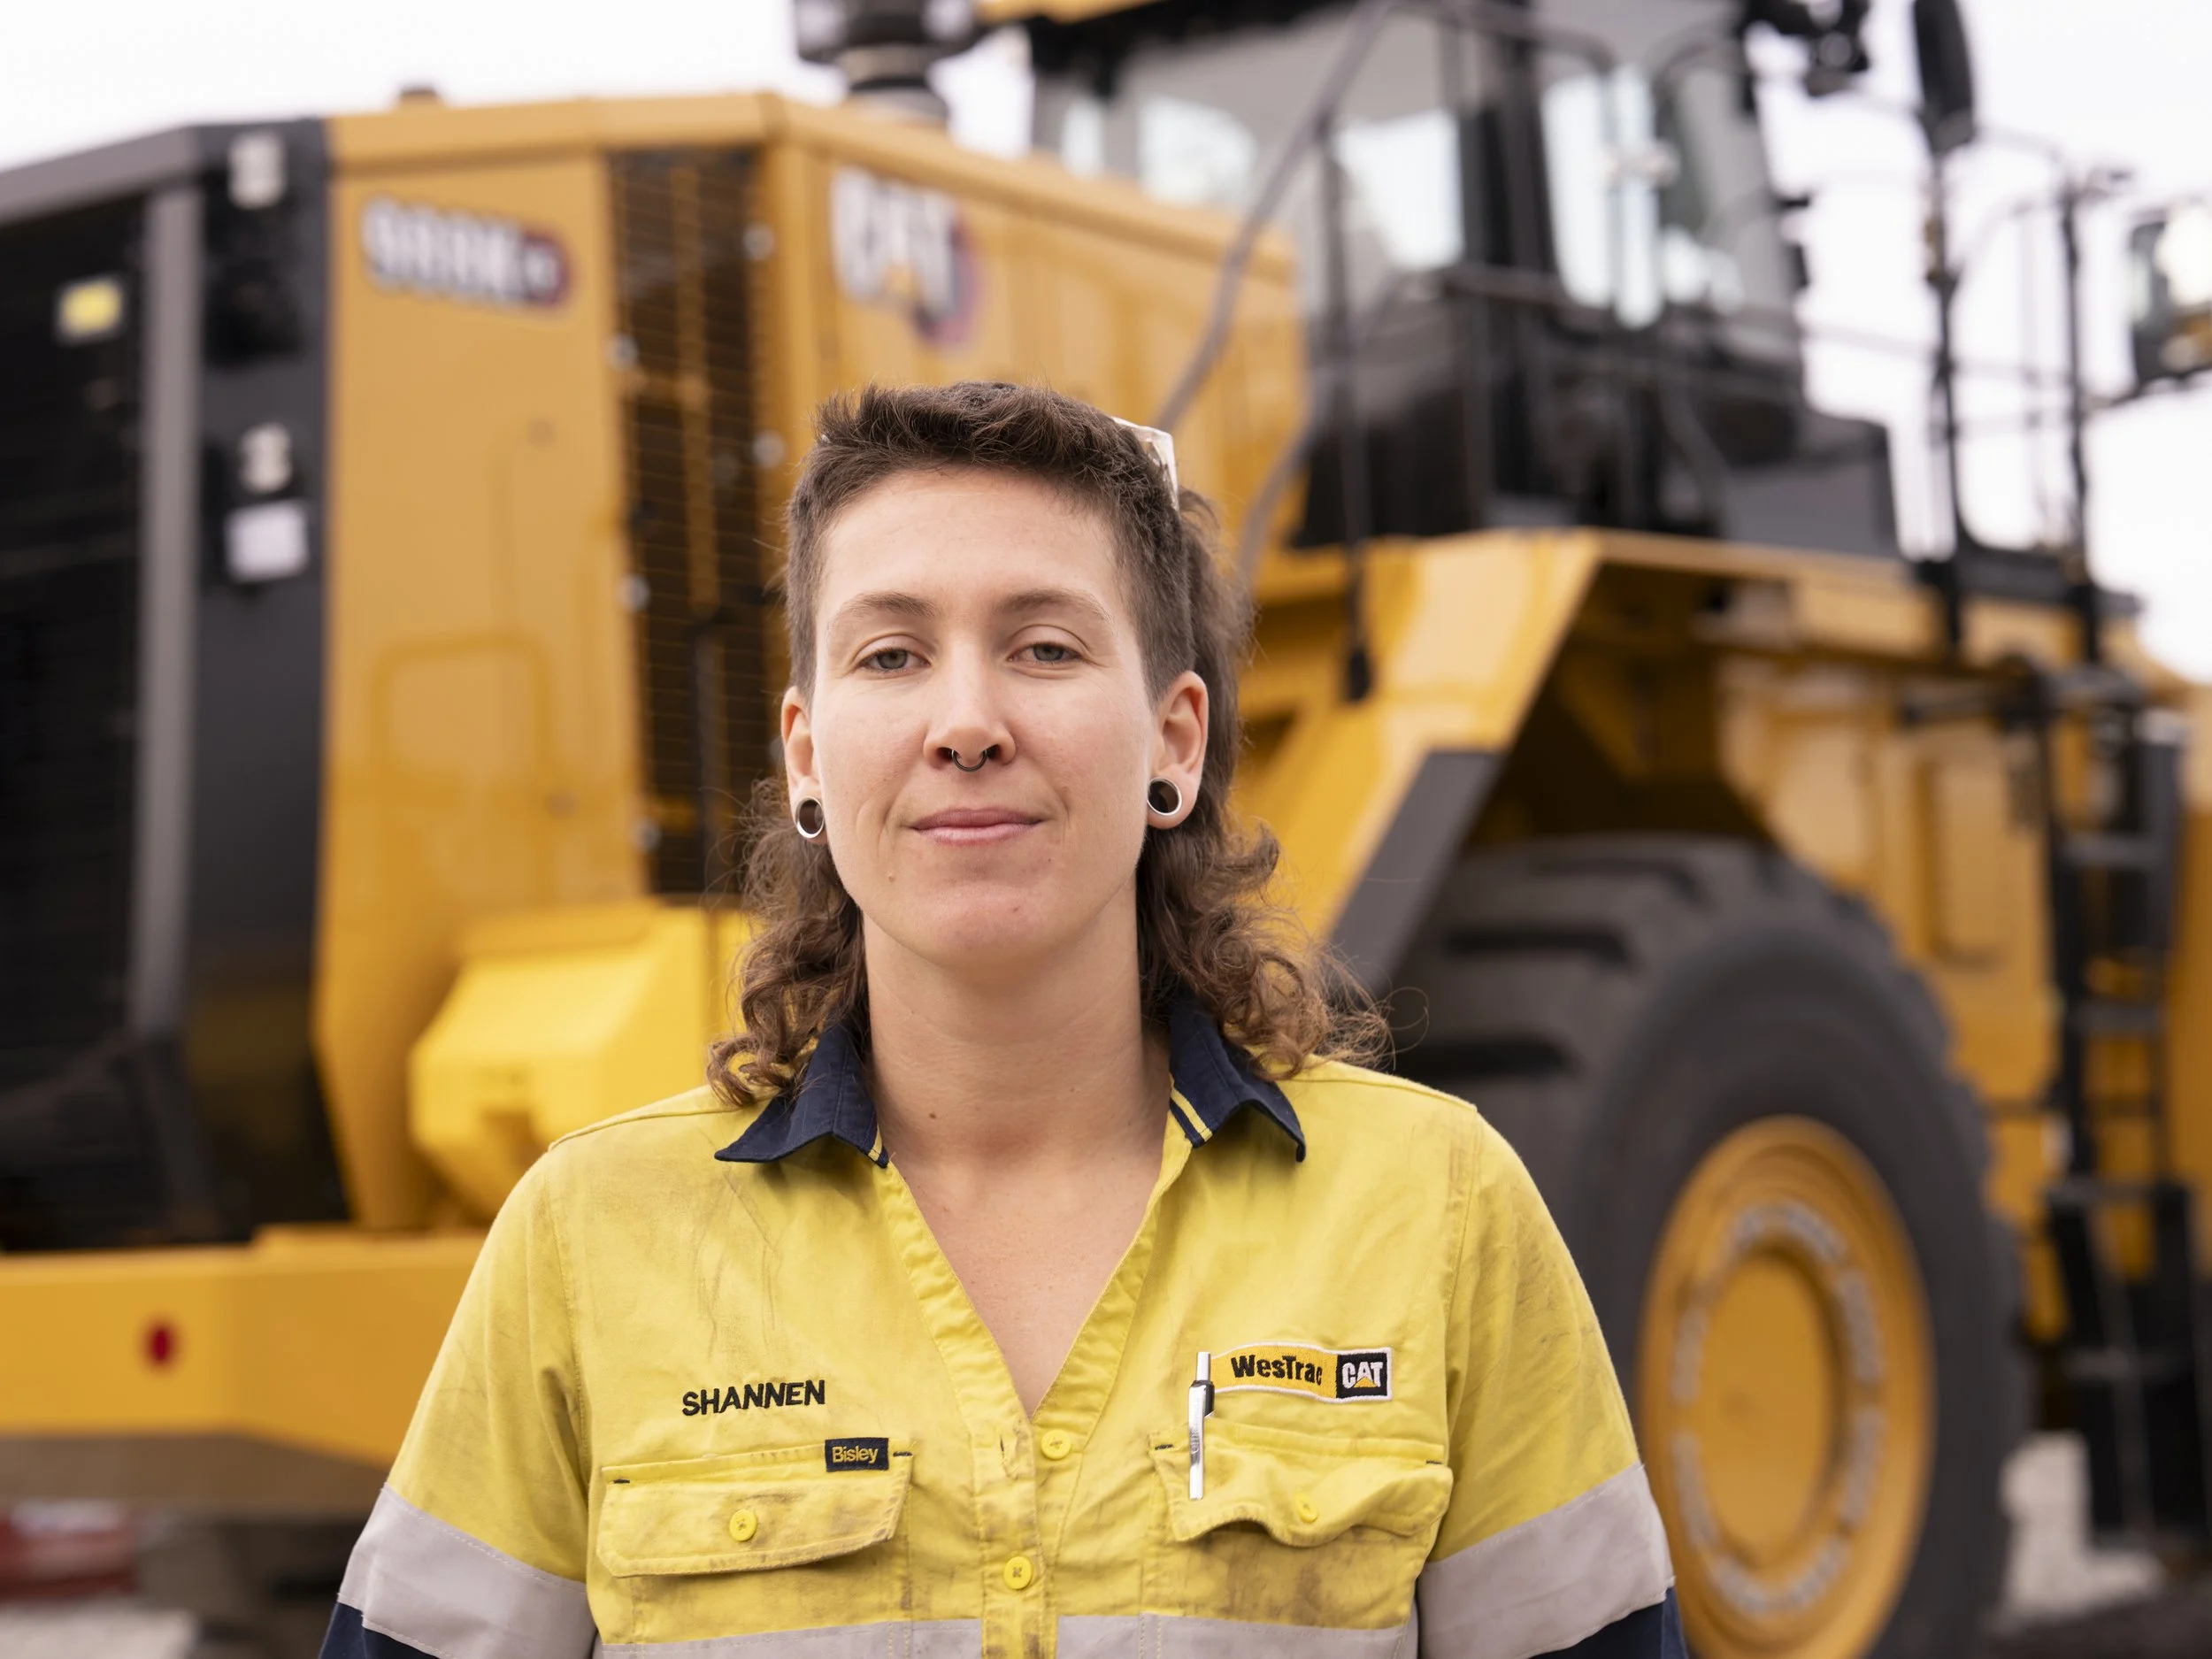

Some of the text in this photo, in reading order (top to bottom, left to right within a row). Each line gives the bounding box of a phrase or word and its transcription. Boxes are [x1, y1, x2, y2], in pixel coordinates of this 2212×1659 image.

[831, 165, 957, 317] CAT
[1231, 1355, 1384, 1389] WesTrac CAT
[681, 1379, 826, 1416] SHANNEN
[832, 1446, 879, 1464] Bisley
